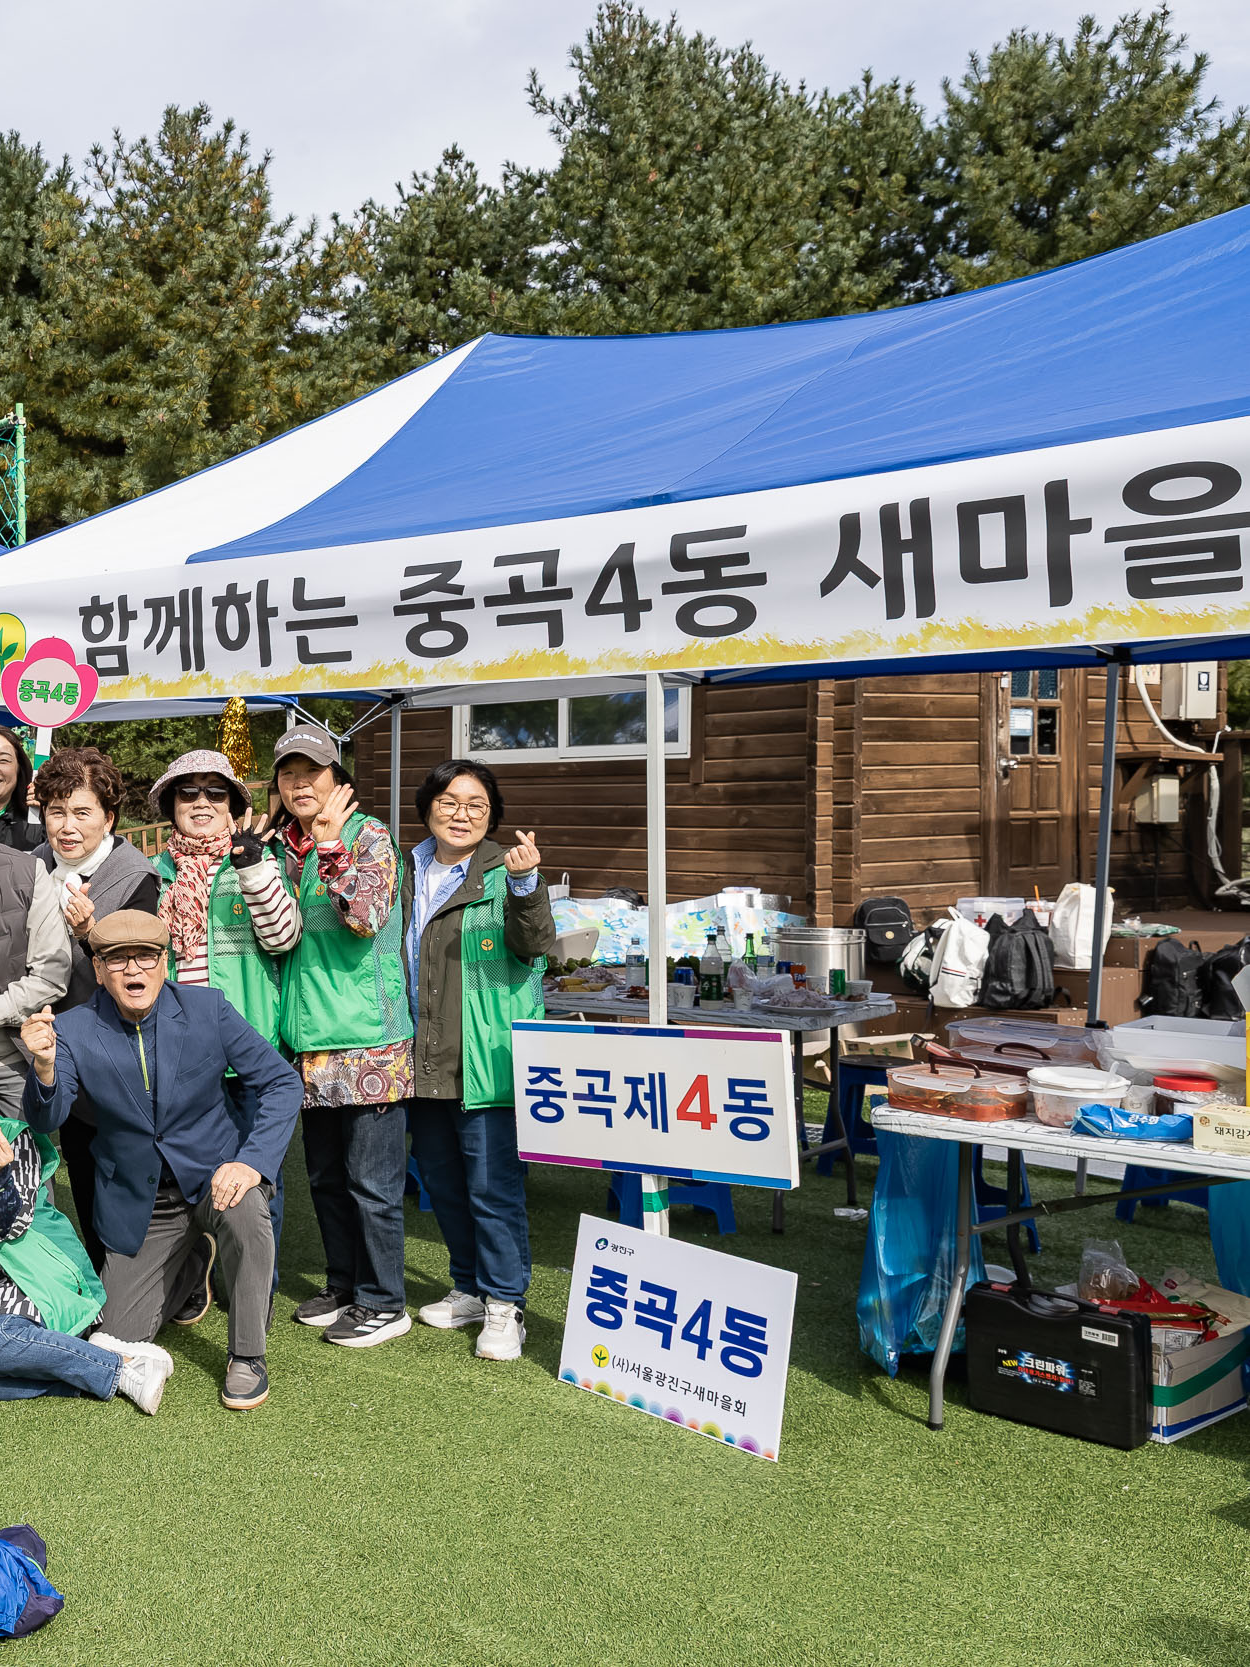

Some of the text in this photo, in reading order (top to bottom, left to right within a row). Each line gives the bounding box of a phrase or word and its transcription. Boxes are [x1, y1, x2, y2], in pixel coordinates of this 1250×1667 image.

[78, 461, 1250, 677] 함께하는 중곡4동 새마을
[18, 679, 79, 705] 중곡4동
[525, 1066, 774, 1142] 중곡제4동
[1214, 1126, 1250, 1140] 돼지감
[610, 1243, 635, 1256] 광진구
[585, 1265, 769, 1379] 중곡4동
[611, 1355, 747, 1417] (사)서울광진구새마을회
